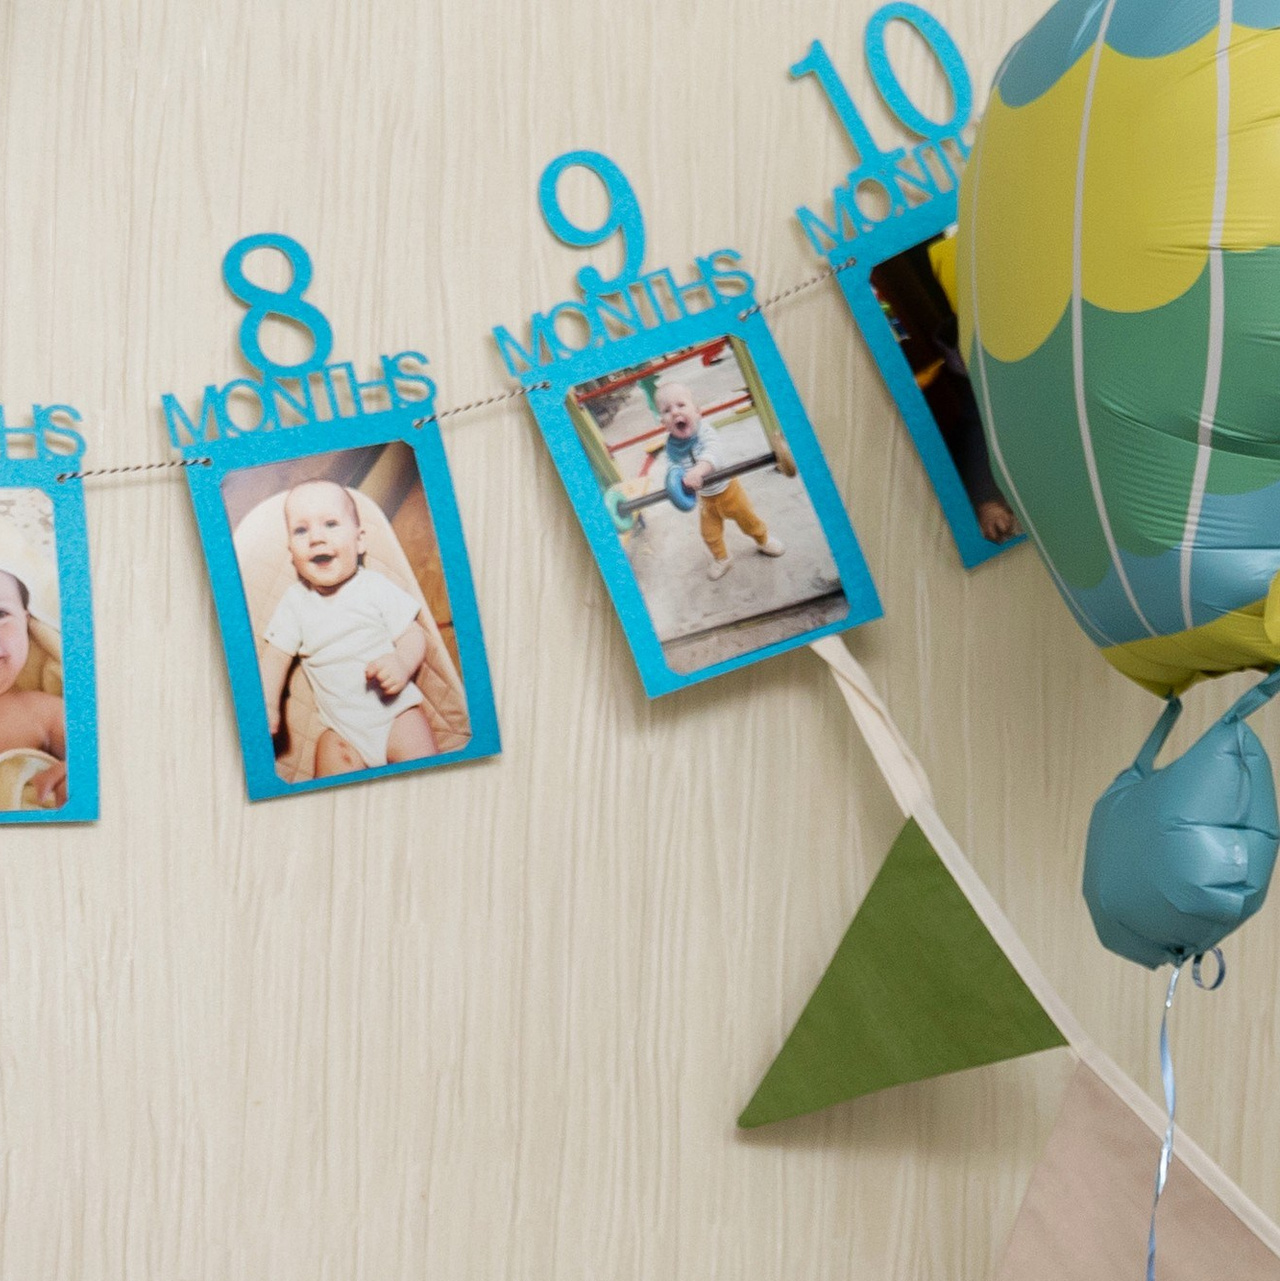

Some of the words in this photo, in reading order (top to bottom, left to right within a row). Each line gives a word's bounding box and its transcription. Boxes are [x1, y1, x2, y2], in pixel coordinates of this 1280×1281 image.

[790, 2, 973, 168] 10
[537, 149, 645, 298] 9
[795, 138, 972, 256] MONT
[222, 233, 334, 378] 8
[492, 248, 756, 378] MONTHS
[162, 350, 437, 450] MONTHS
